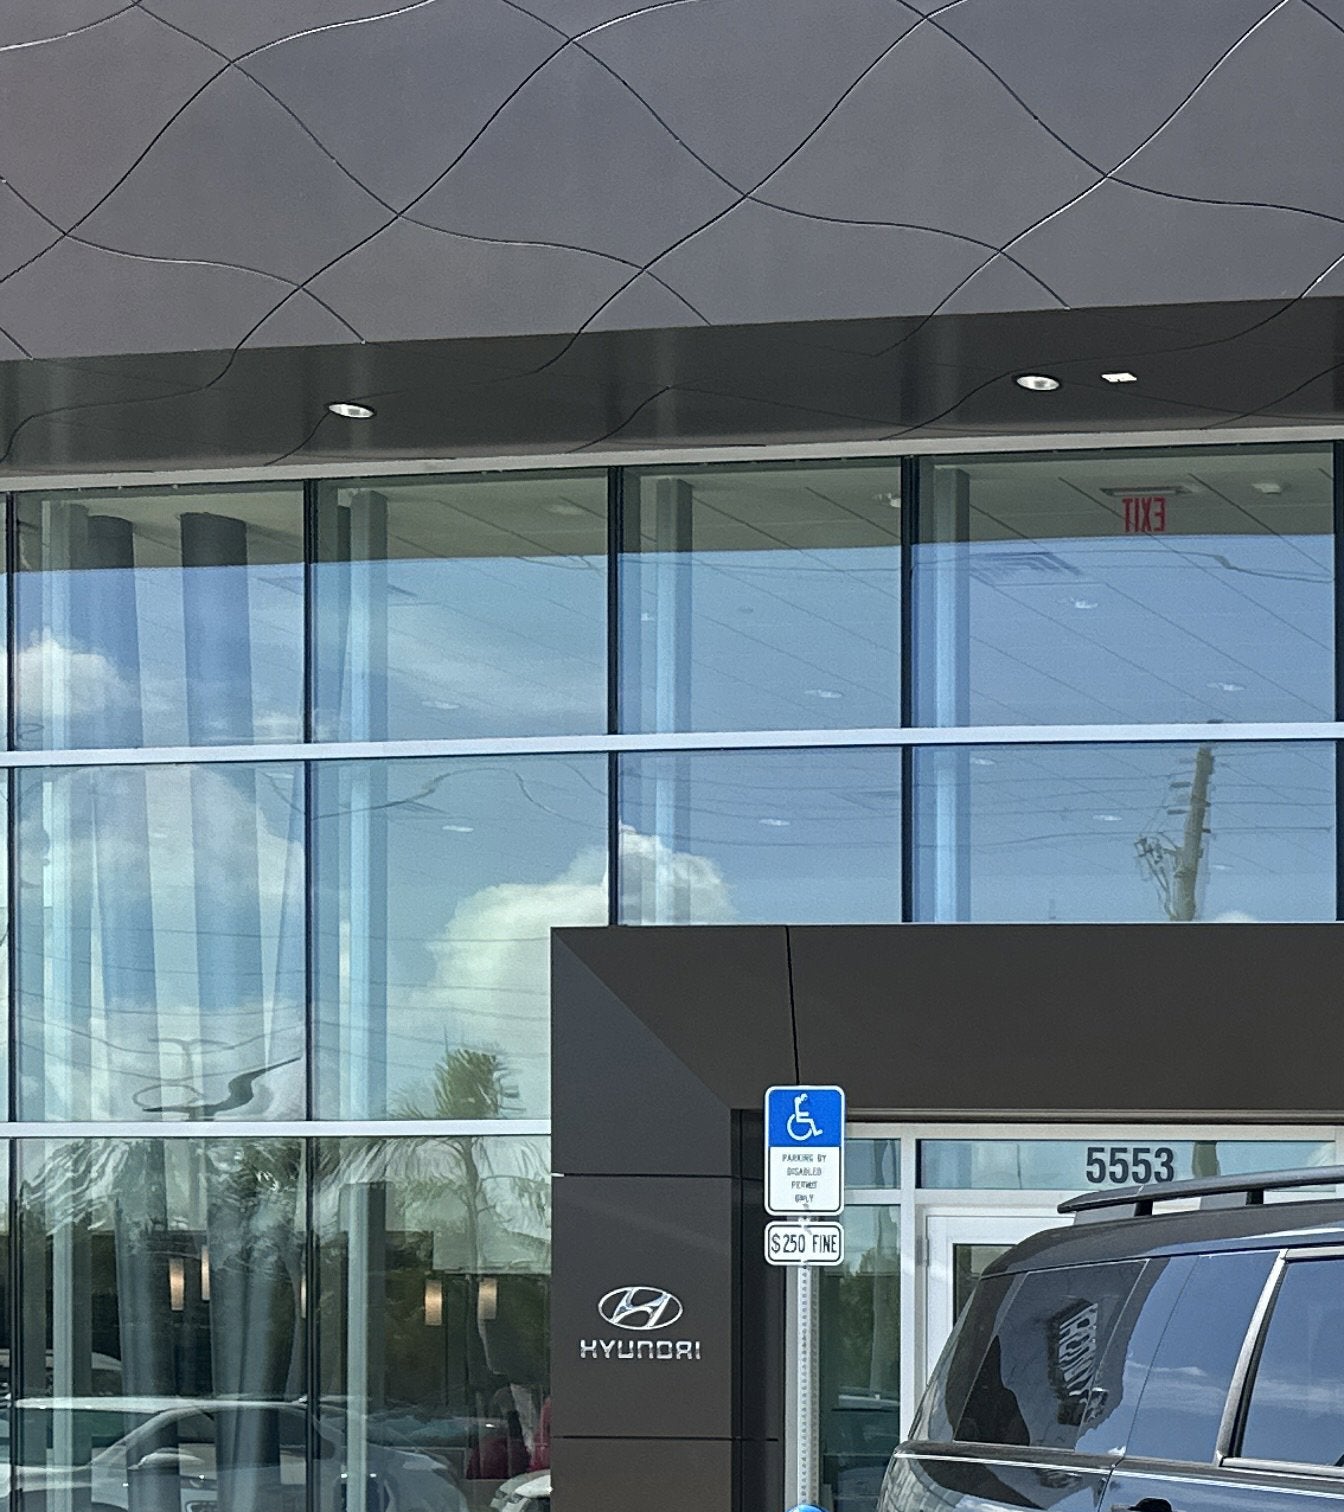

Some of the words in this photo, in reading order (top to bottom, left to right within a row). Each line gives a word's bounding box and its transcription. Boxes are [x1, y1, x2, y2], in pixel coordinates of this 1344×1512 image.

[817, 1154, 827, 1162] BY
[1086, 1147, 1174, 1184] 5553
[771, 1233, 806, 1254] $250
[812, 1234, 837, 1253] FINE
[580, 1339, 701, 1360] HYUNDAI
